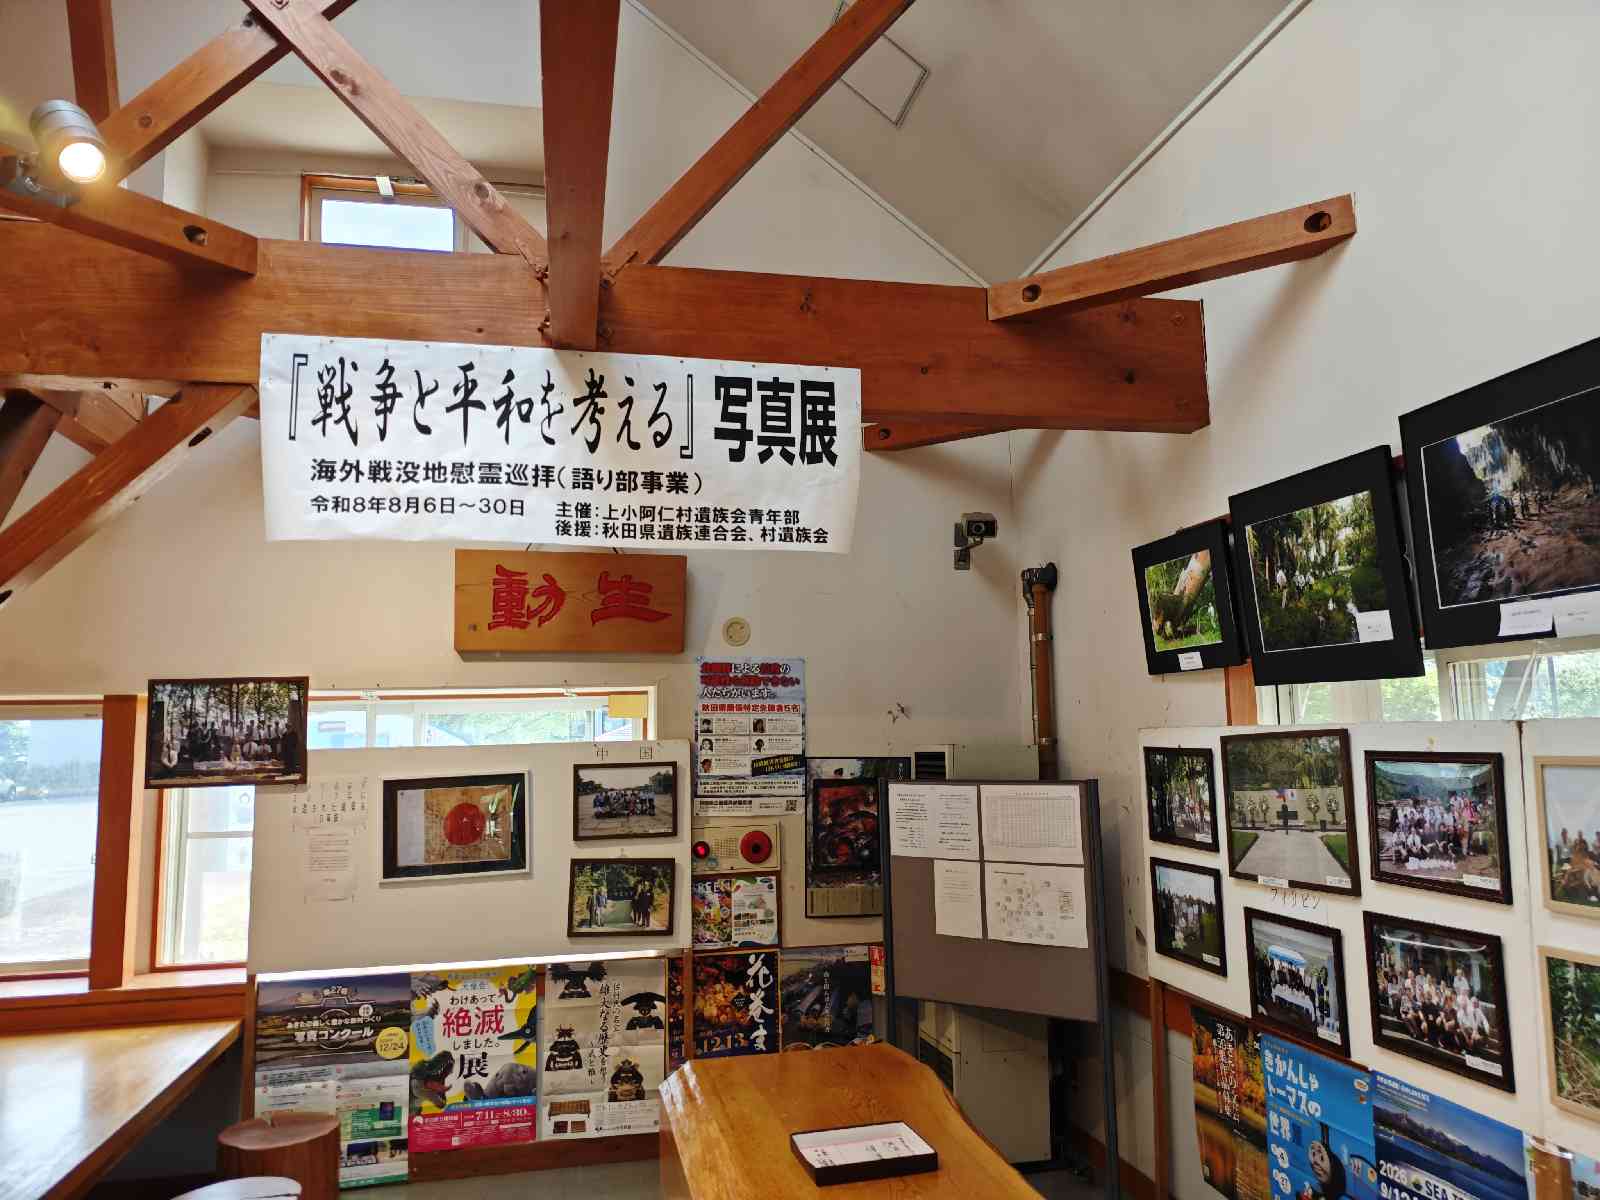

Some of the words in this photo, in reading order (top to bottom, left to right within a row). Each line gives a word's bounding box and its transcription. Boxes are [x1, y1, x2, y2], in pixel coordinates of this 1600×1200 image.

[714, 376, 838, 467] 写真展
[450, 994, 497, 1005] わけあって
[442, 1004, 504, 1038] 絶滅
[453, 1038, 500, 1051] しました。
[457, 1051, 488, 1079] 展
[1264, 1049, 1319, 1092] きかんしゃ
[1267, 1075, 1321, 1118] トーマスの
[1379, 1159, 1408, 1184] 2026
